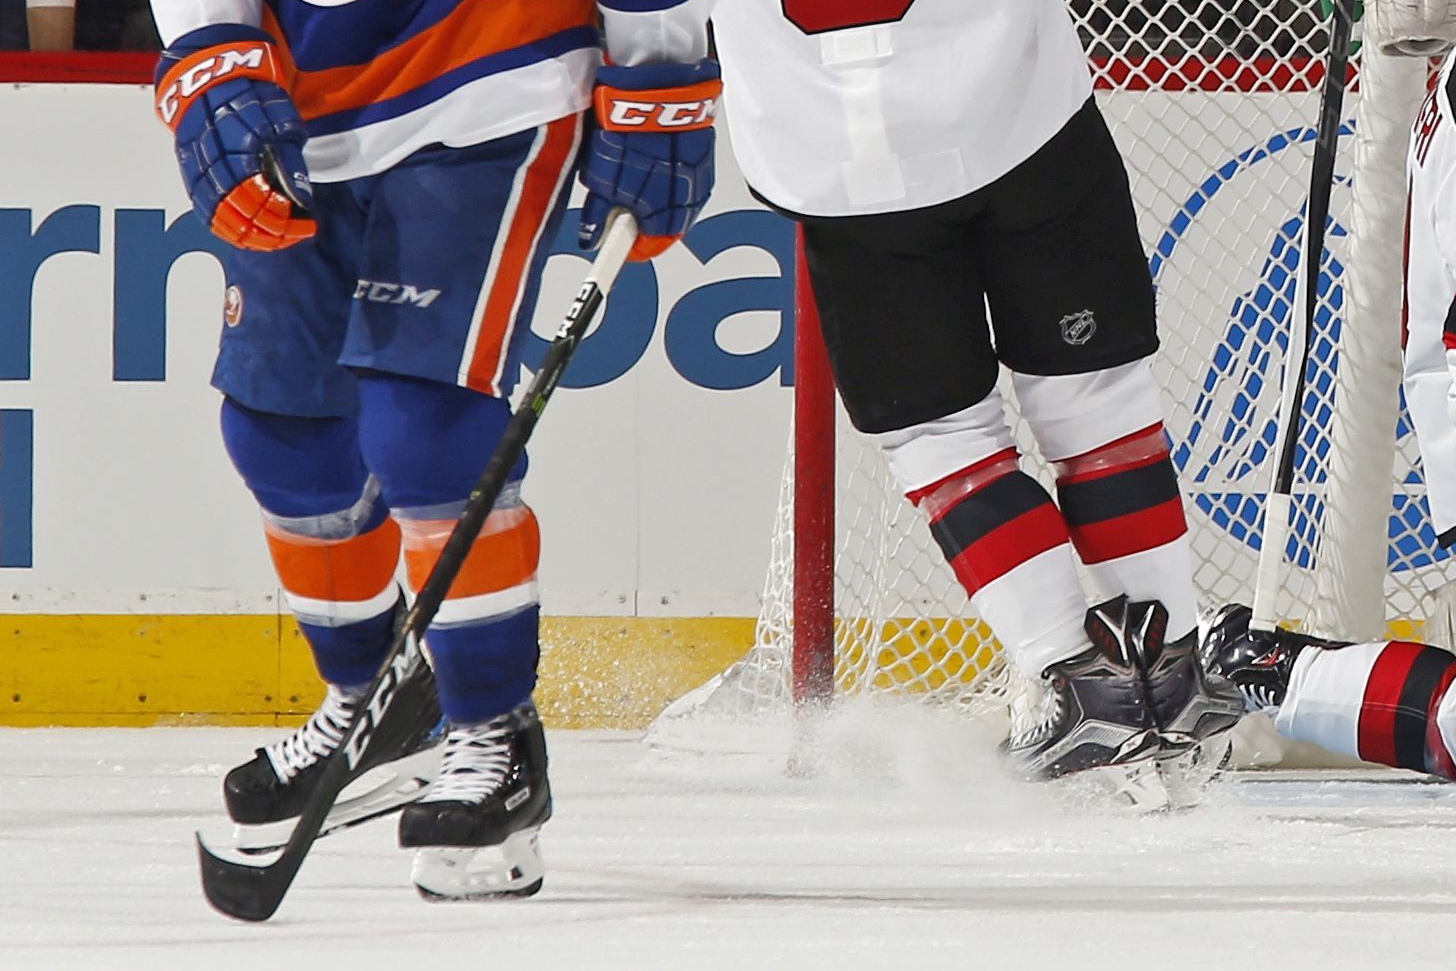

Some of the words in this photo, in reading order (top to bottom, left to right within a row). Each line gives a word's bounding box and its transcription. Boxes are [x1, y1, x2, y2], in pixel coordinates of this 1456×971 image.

[160, 48, 264, 123] CCM
[353, 279, 441, 309] CCM
[556, 281, 592, 340] CCM
[342, 629, 423, 772] CCM
